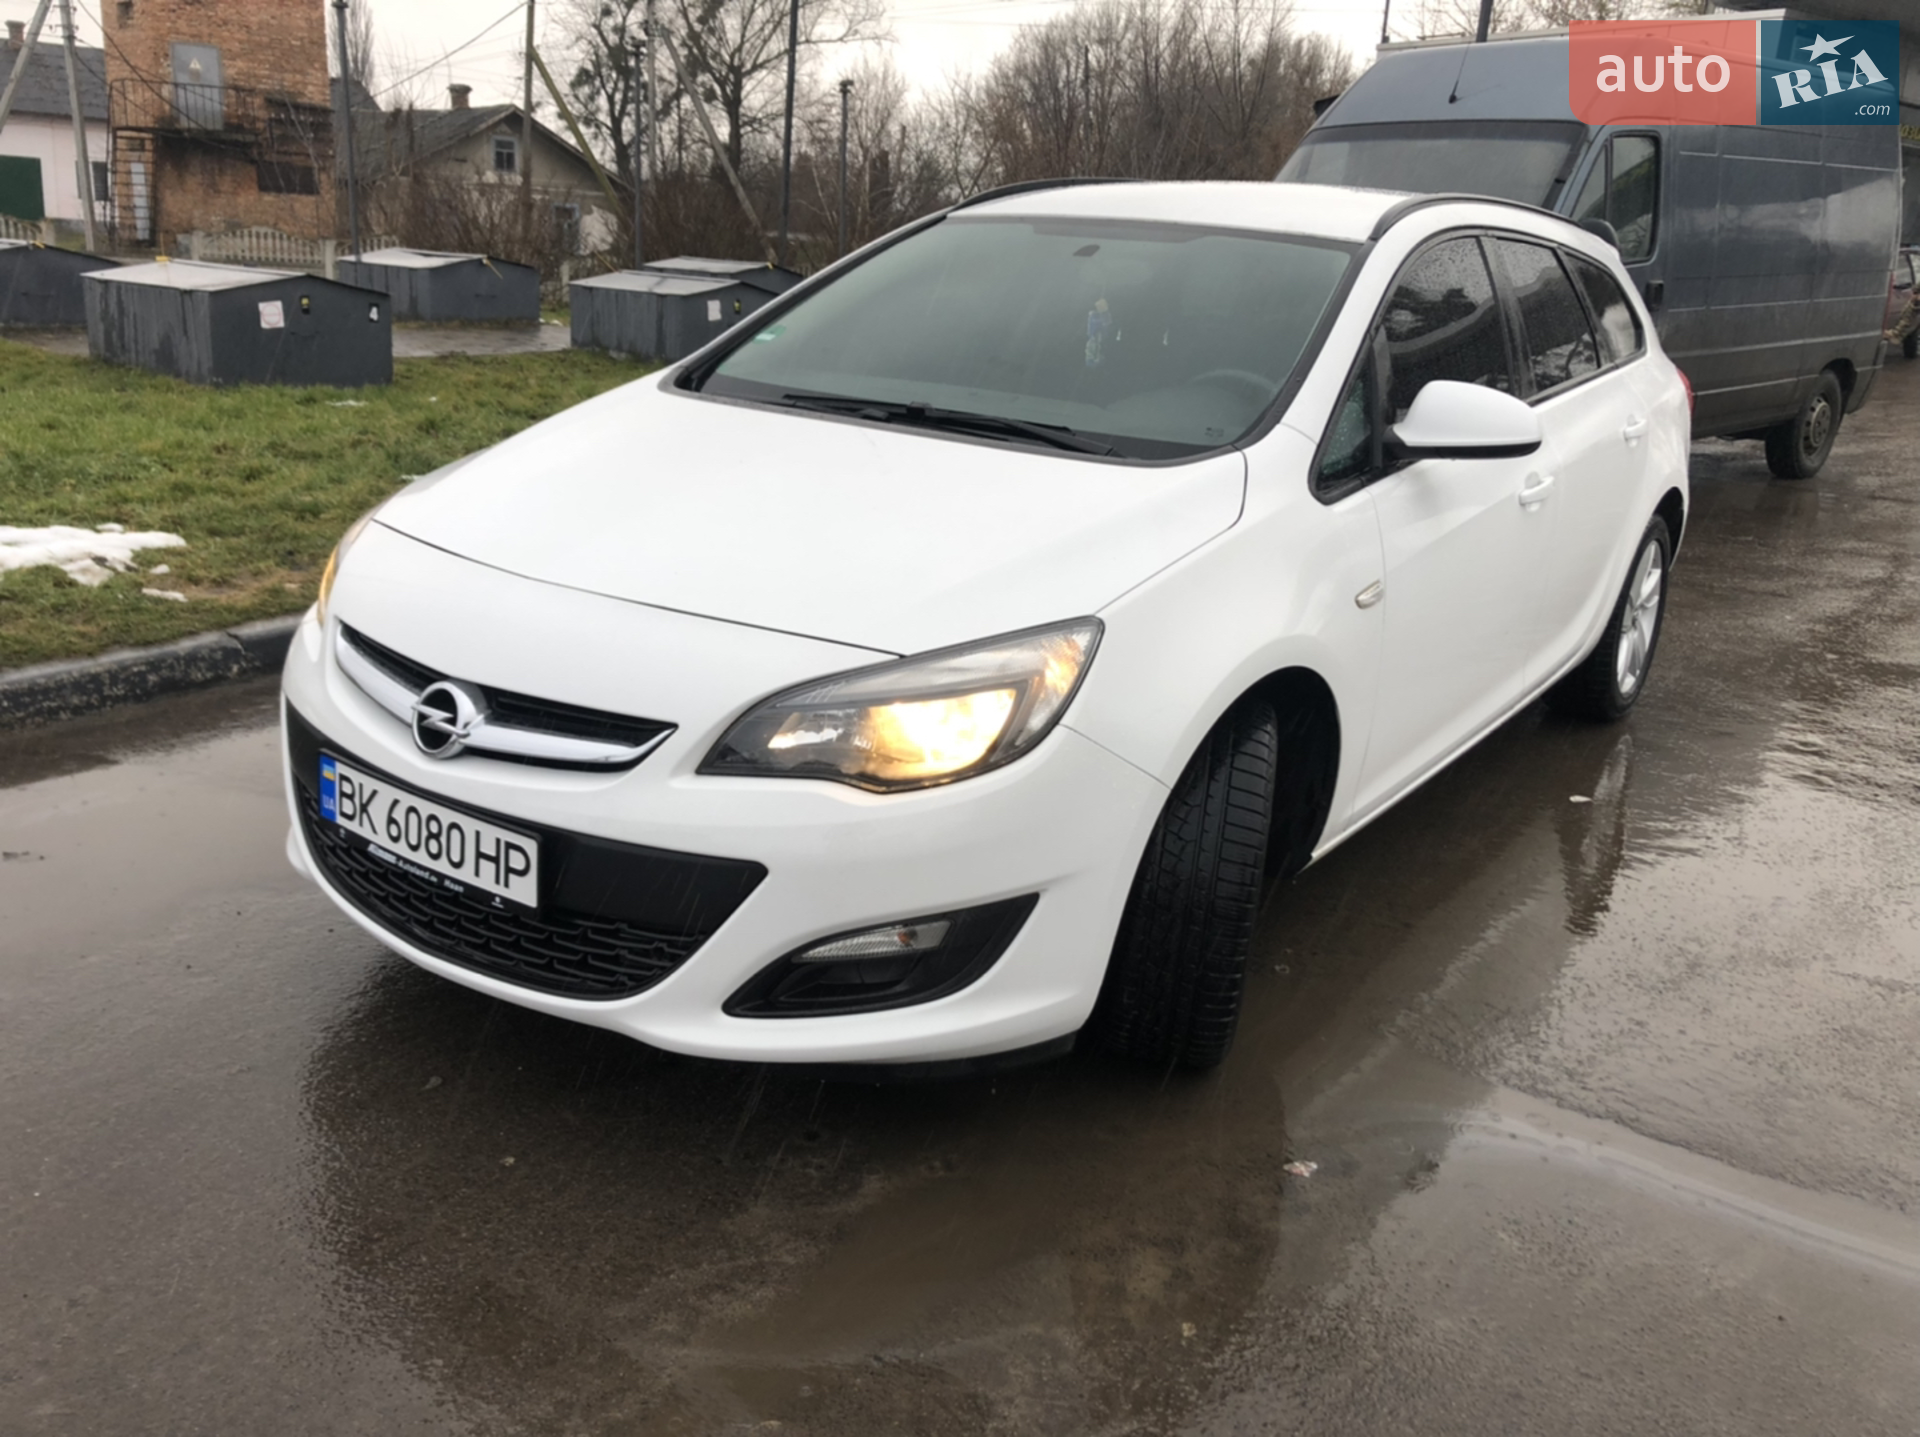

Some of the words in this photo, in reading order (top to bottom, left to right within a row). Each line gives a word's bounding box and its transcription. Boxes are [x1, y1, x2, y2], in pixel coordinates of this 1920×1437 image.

[338, 772, 378, 836] BK
[386, 798, 465, 870] 6080
[474, 829, 531, 889] HP
